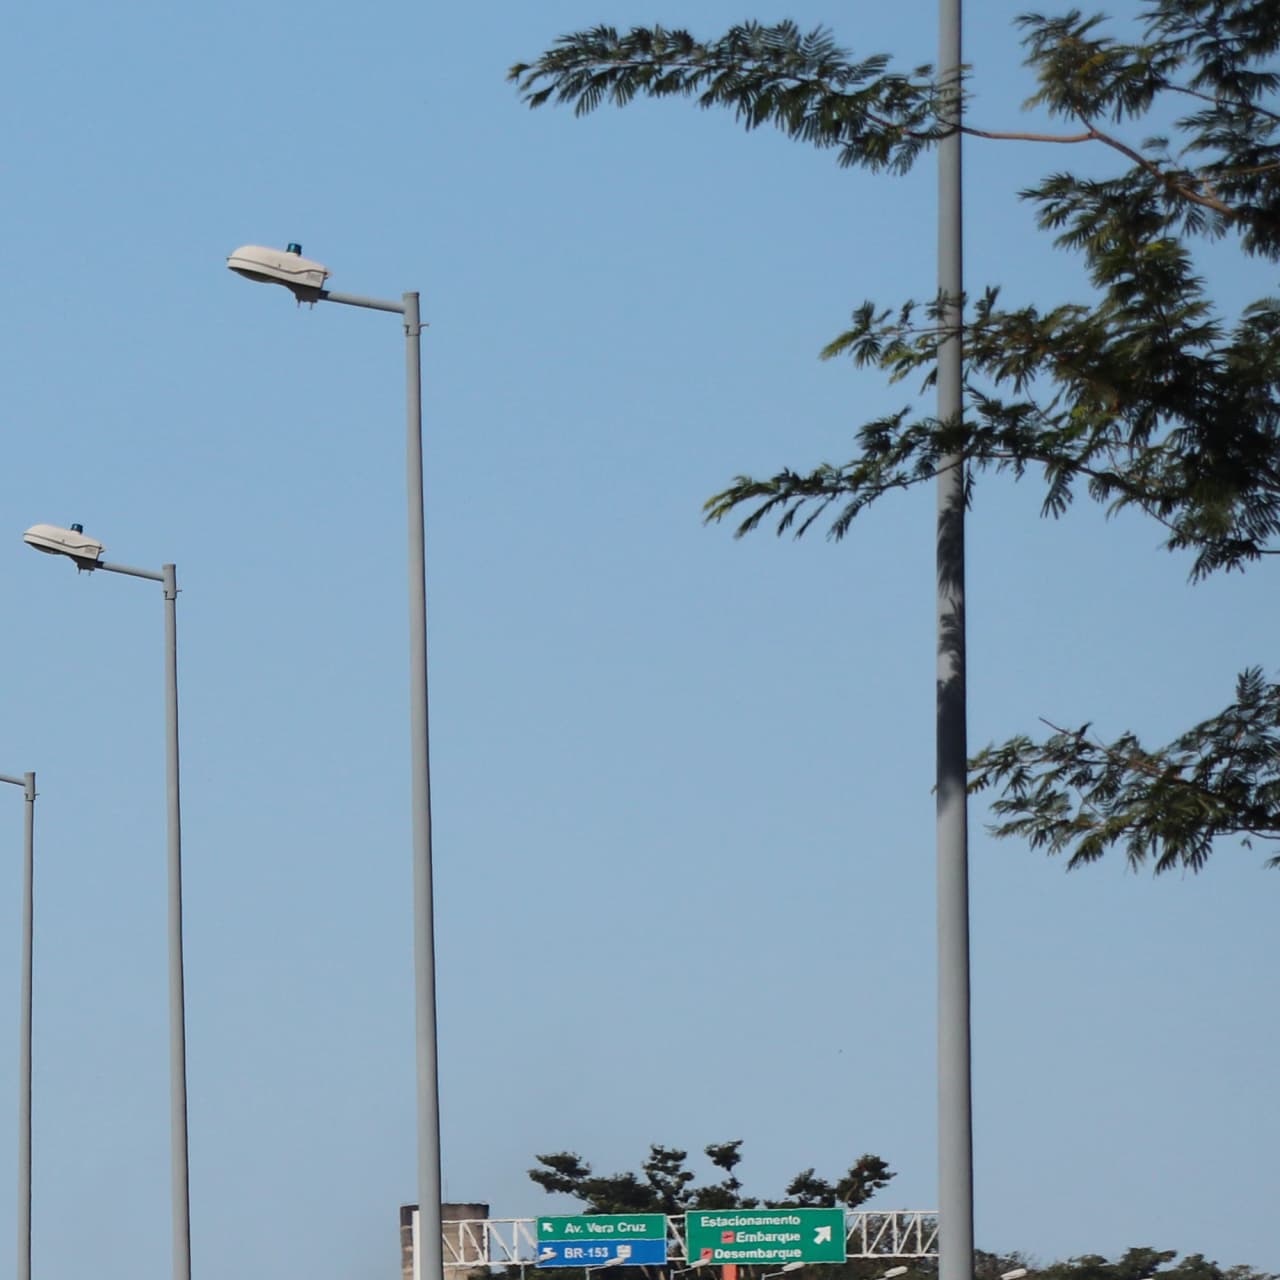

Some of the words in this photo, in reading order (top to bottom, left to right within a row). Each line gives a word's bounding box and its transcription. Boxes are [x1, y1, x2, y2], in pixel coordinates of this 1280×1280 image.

[701, 1216, 801, 1227] Estacionamento
[564, 1223, 584, 1233] Av.
[586, 1222, 614, 1233] Vera
[617, 1222, 647, 1232] Cruz
[736, 1231, 801, 1244] Embarque
[564, 1247, 609, 1258] BR-153
[714, 1249, 802, 1260] Desembarque
